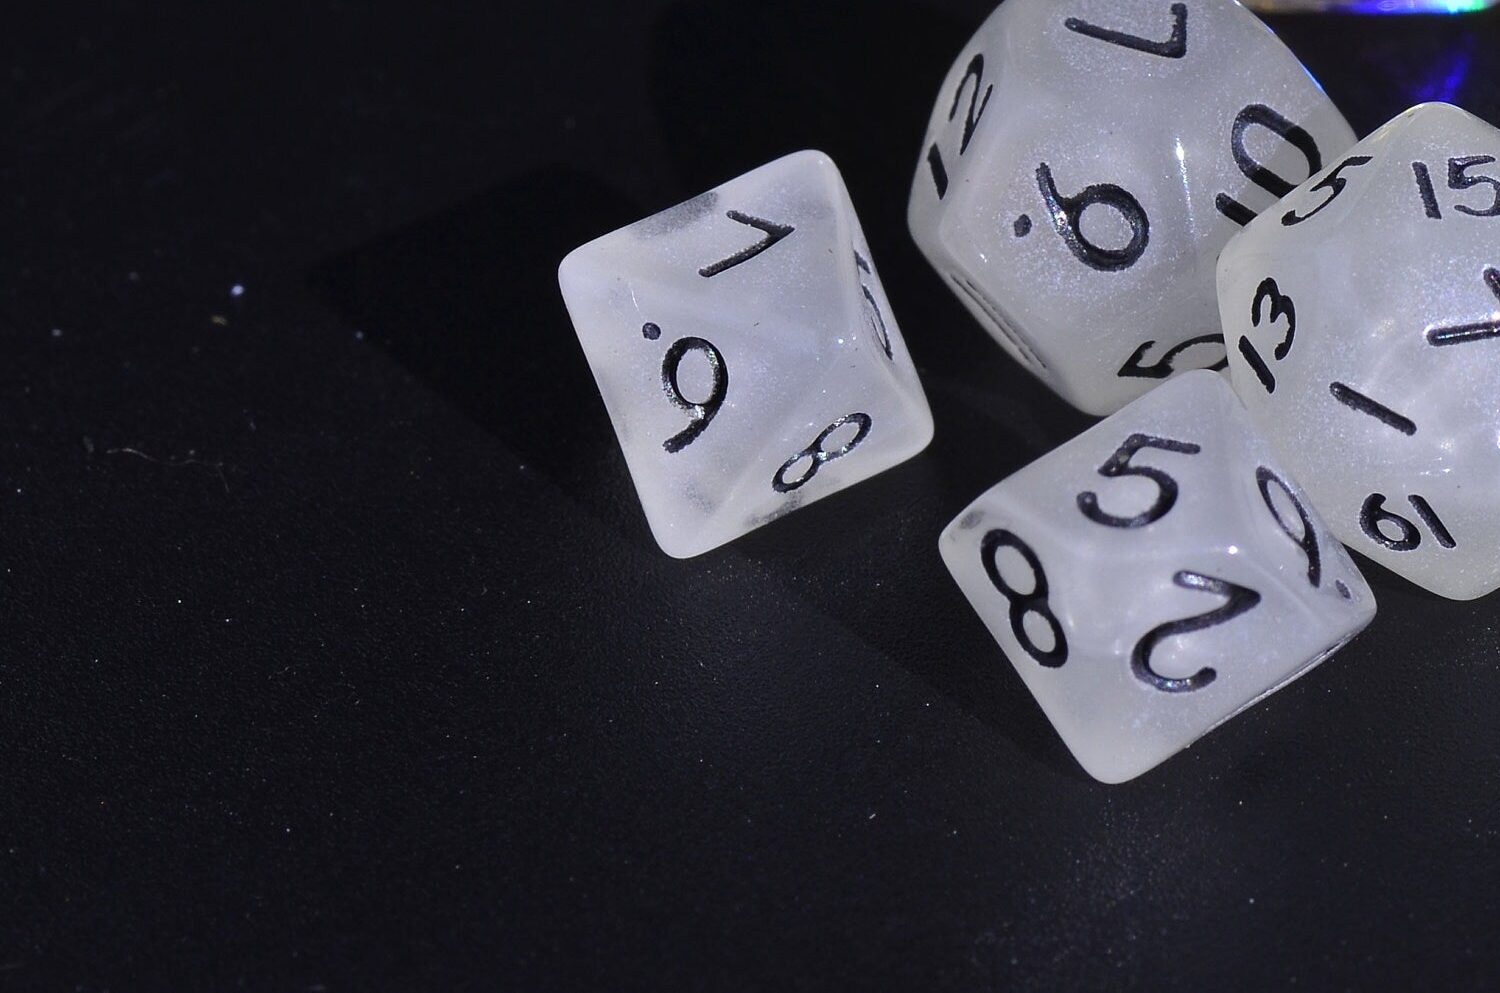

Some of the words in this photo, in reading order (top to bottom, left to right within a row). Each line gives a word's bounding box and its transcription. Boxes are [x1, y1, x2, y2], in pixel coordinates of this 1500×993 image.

[1064, 2, 1188, 59] 7
[927, 53, 993, 201] 12
[698, 209, 797, 279] 7
[1237, 276, 1297, 394] 13
[771, 411, 873, 495] 8
[1330, 381, 1418, 437] 1
[1076, 432, 1202, 529] 5
[979, 527, 1069, 669] 8
[1130, 568, 1262, 693] 2
